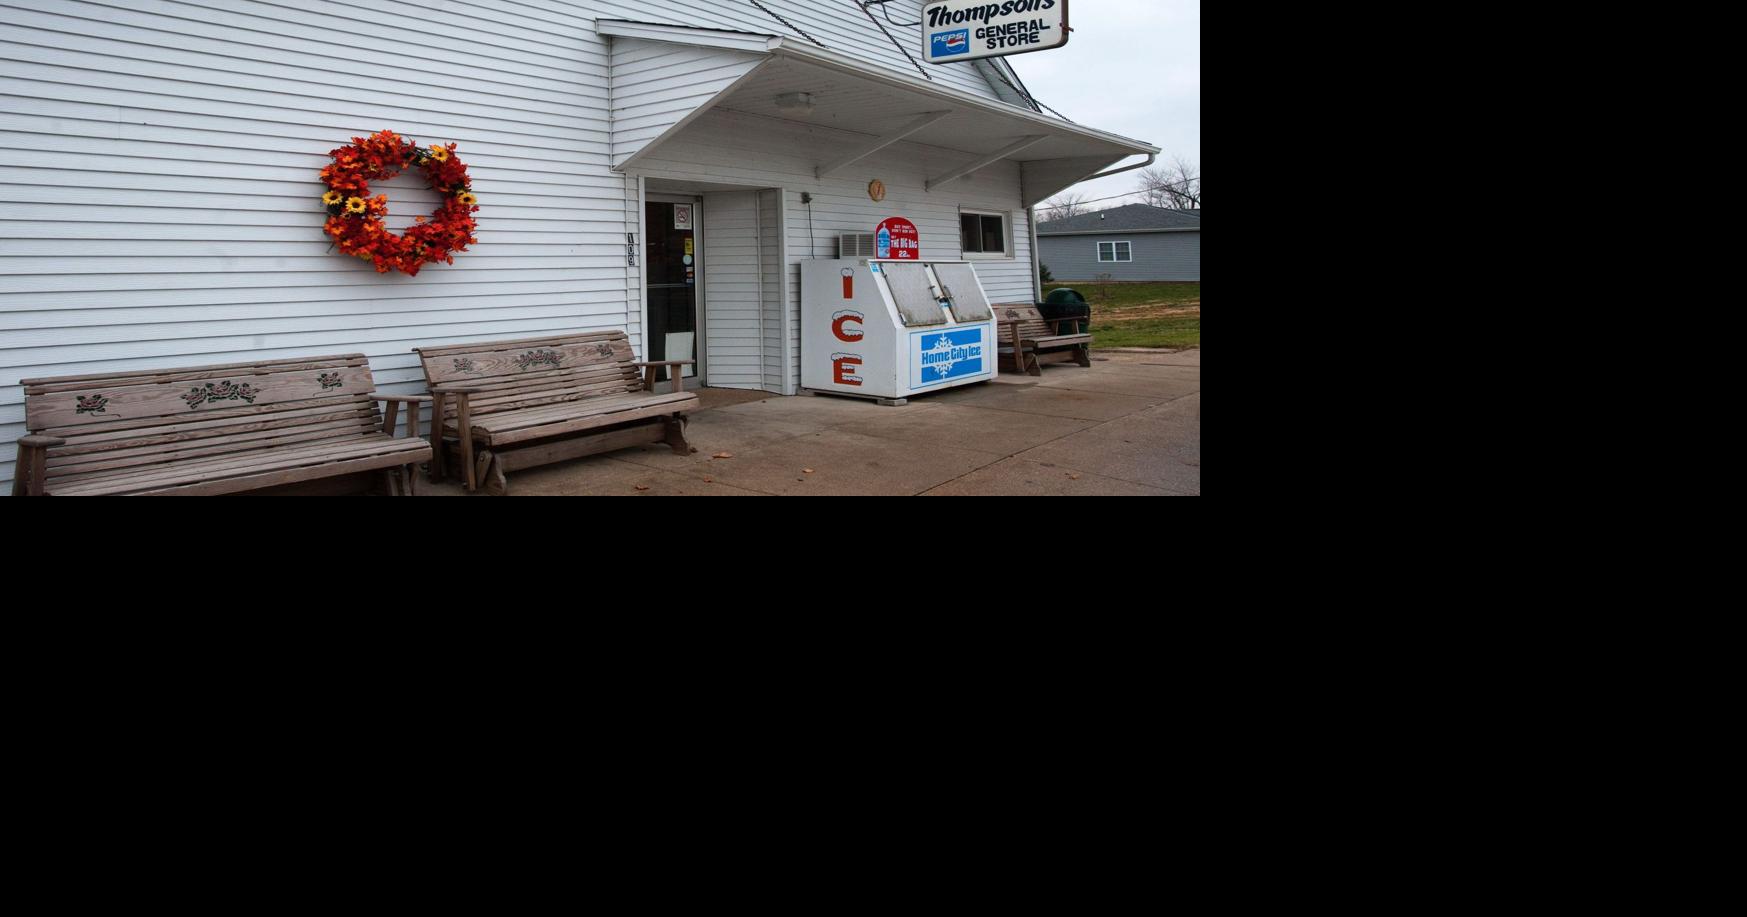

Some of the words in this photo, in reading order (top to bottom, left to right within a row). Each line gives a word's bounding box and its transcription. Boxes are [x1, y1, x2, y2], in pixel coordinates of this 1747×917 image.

[933, 32, 967, 43] PEPSI
[975, 18, 1051, 39] GENERAL
[986, 31, 1040, 50] STORE
[891, 239, 899, 248] THE
[831, 266, 864, 387] ICE
[922, 350, 949, 365] Home
[950, 346, 968, 360] City
[968, 345, 981, 357] Ice
